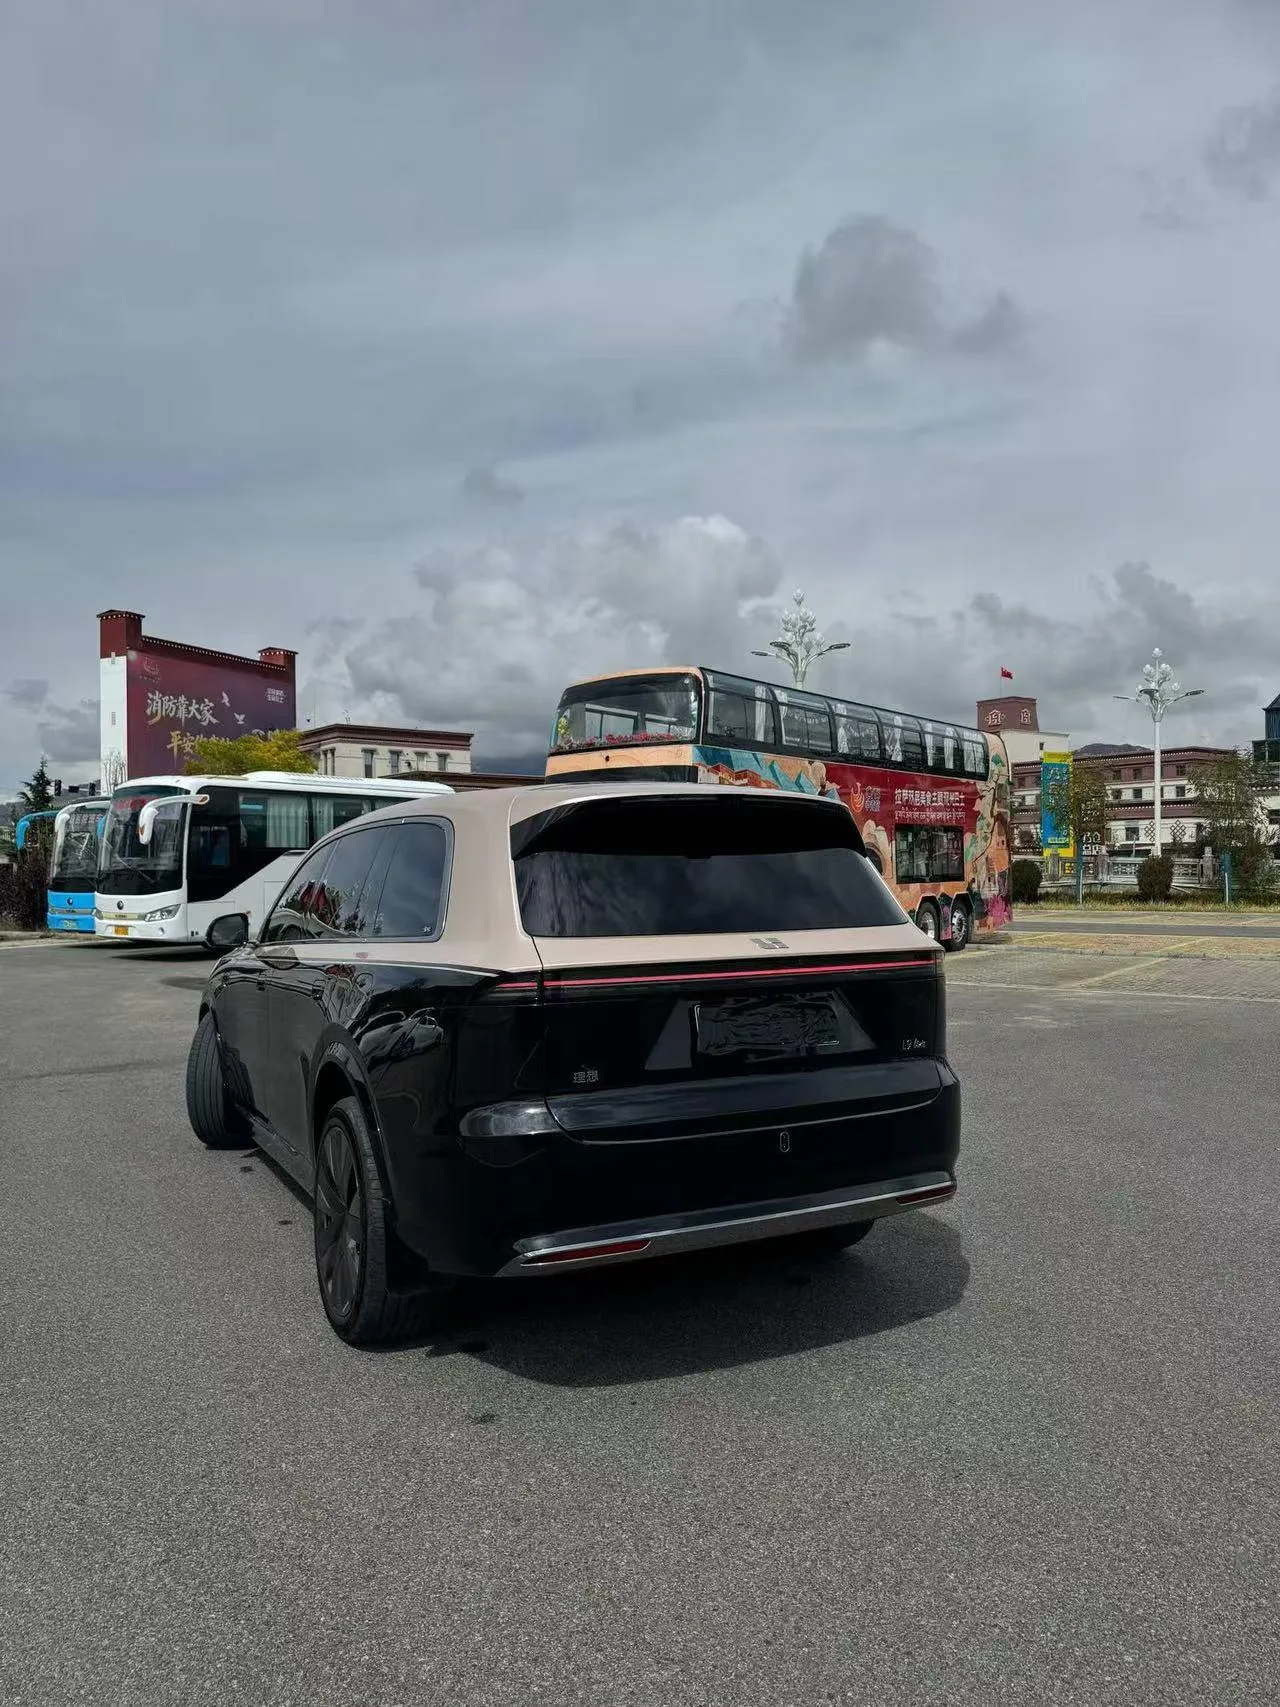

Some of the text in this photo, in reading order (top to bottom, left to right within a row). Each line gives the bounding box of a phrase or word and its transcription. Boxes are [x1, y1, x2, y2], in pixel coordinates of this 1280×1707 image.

[146, 690, 220, 727] 消防靠大家
[573, 1070, 599, 1084] 理想
